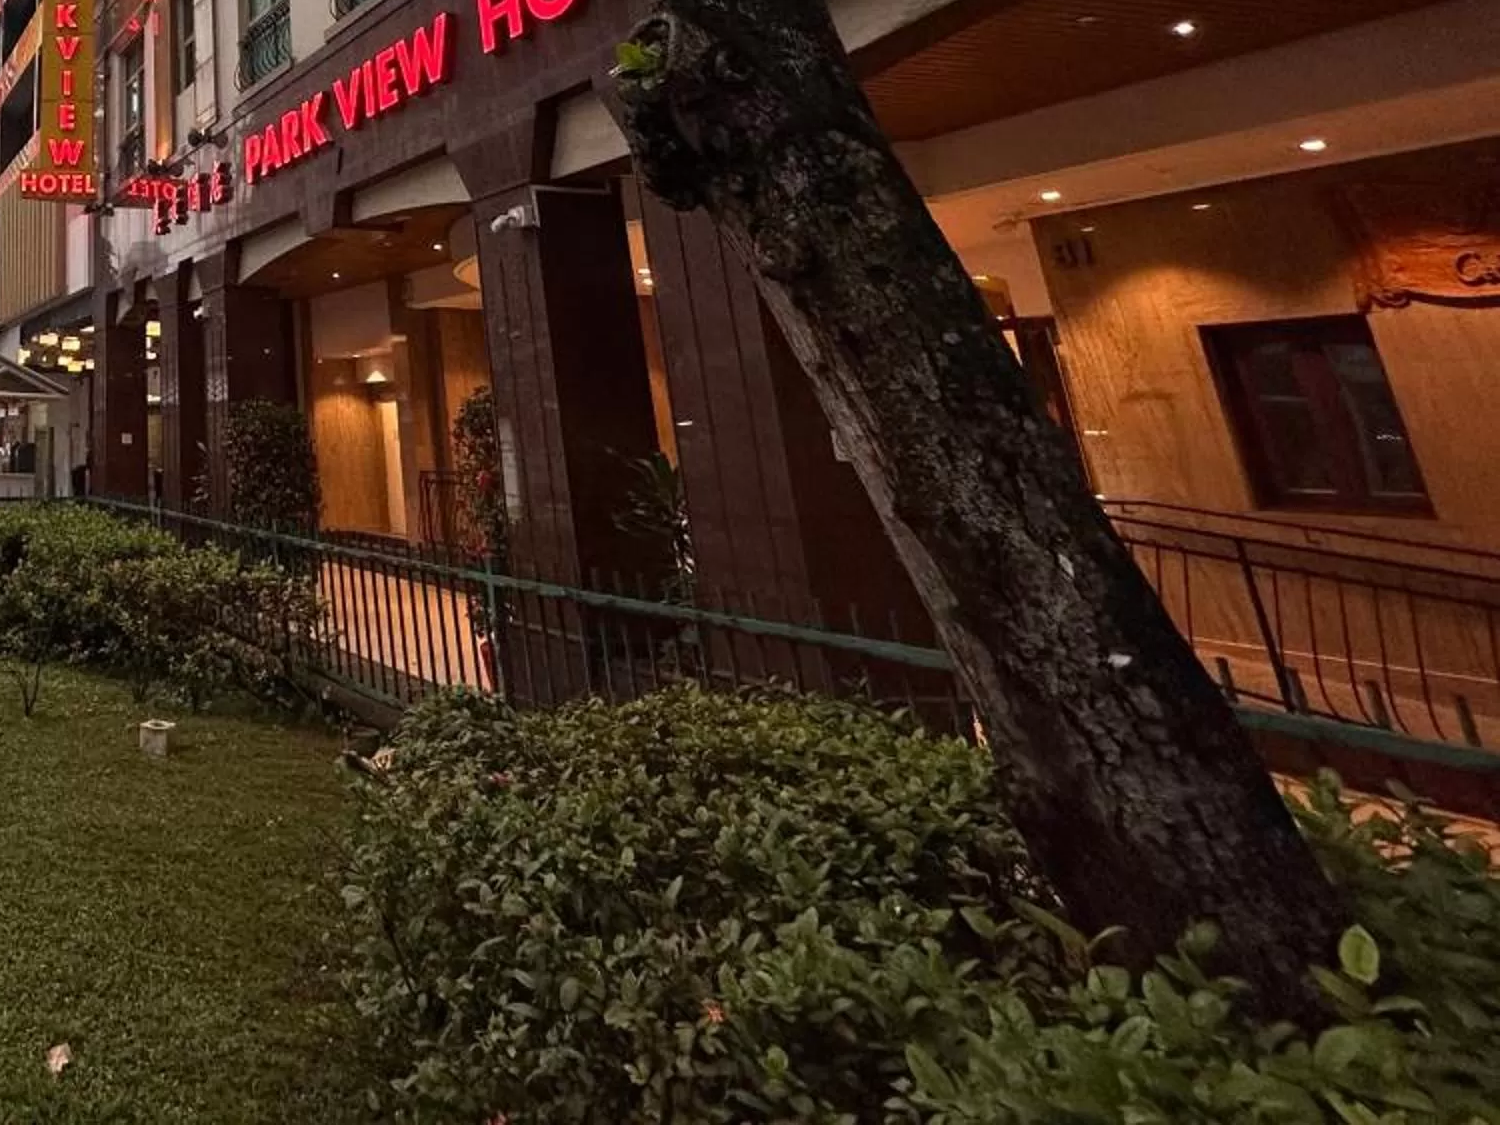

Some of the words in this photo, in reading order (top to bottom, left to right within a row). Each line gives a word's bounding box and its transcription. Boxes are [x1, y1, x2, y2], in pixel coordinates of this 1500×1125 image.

[244, 90, 328, 184] PARK
[332, 12, 448, 131] VIEW
[21, 173, 96, 193] HOTEL
